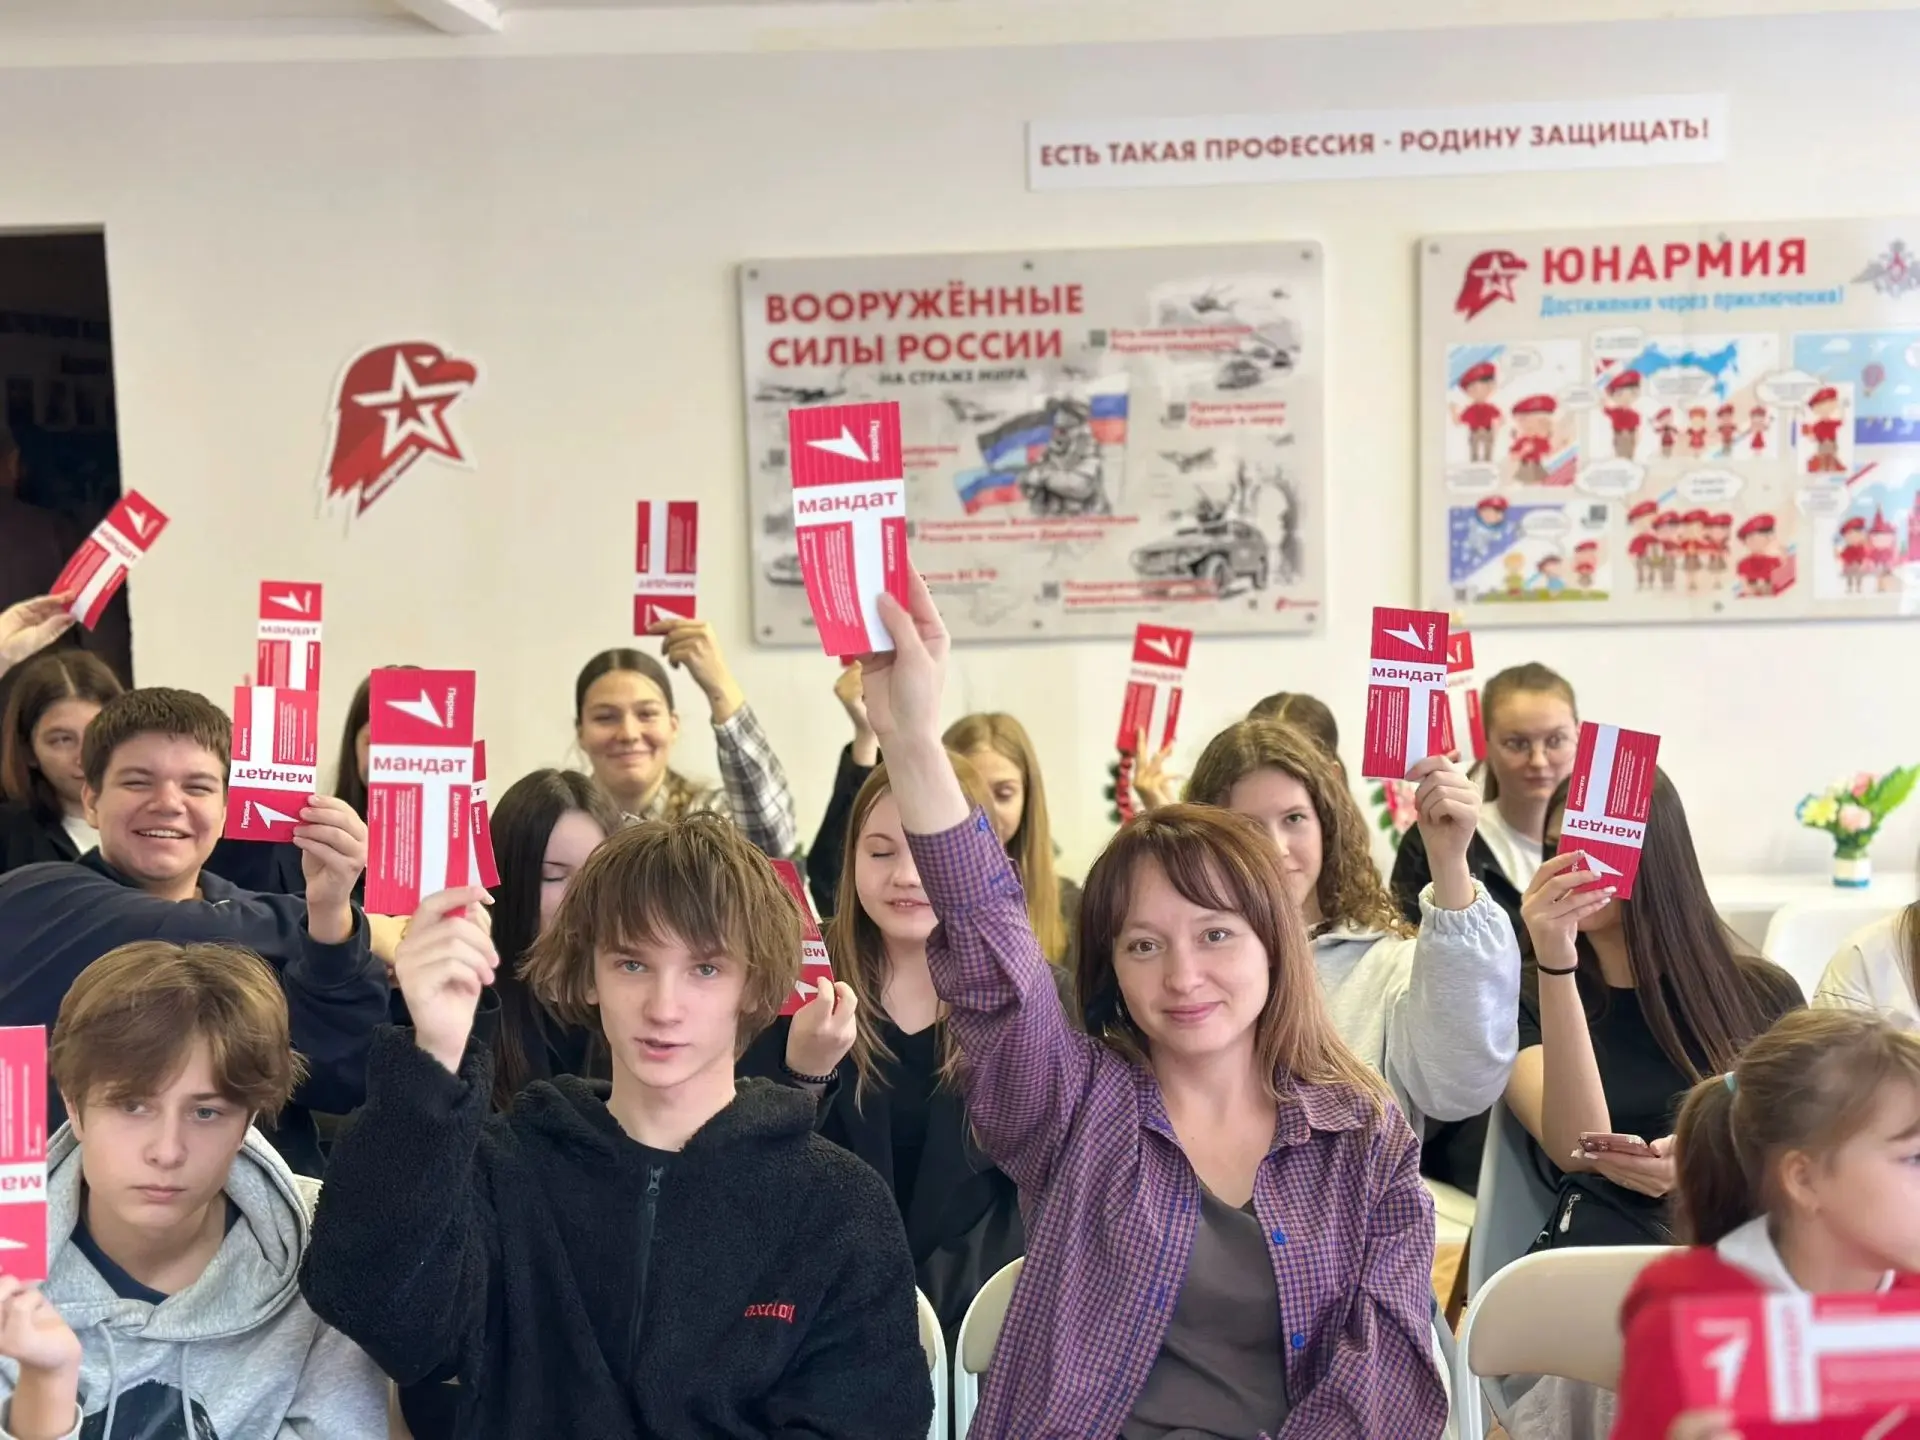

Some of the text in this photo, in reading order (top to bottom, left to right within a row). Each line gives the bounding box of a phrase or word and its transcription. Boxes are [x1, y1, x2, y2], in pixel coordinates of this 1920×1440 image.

[1040, 143, 1100, 166] ЕСТЬ
[1109, 140, 1196, 164] ТАКАЯ
[1205, 133, 1374, 160] ПРОФЕССИЯ
[1401, 126, 1520, 155] РОДИНУ
[1530, 118, 1709, 150] ЗАЩИЩАТЬ!
[1542, 238, 1806, 285] ЮНАРМИЯ
[766, 280, 1084, 324] ВООРУЖЁННЫЕ
[768, 328, 1062, 367] СИЛЫ РОССИИ
[798, 490, 898, 515] мандат
[1372, 666, 1443, 683] мандат
[447, 687, 456, 729] Первые
[234, 767, 313, 785] мандат
[373, 755, 467, 774] мандат
[1567, 818, 1642, 841] мандат
